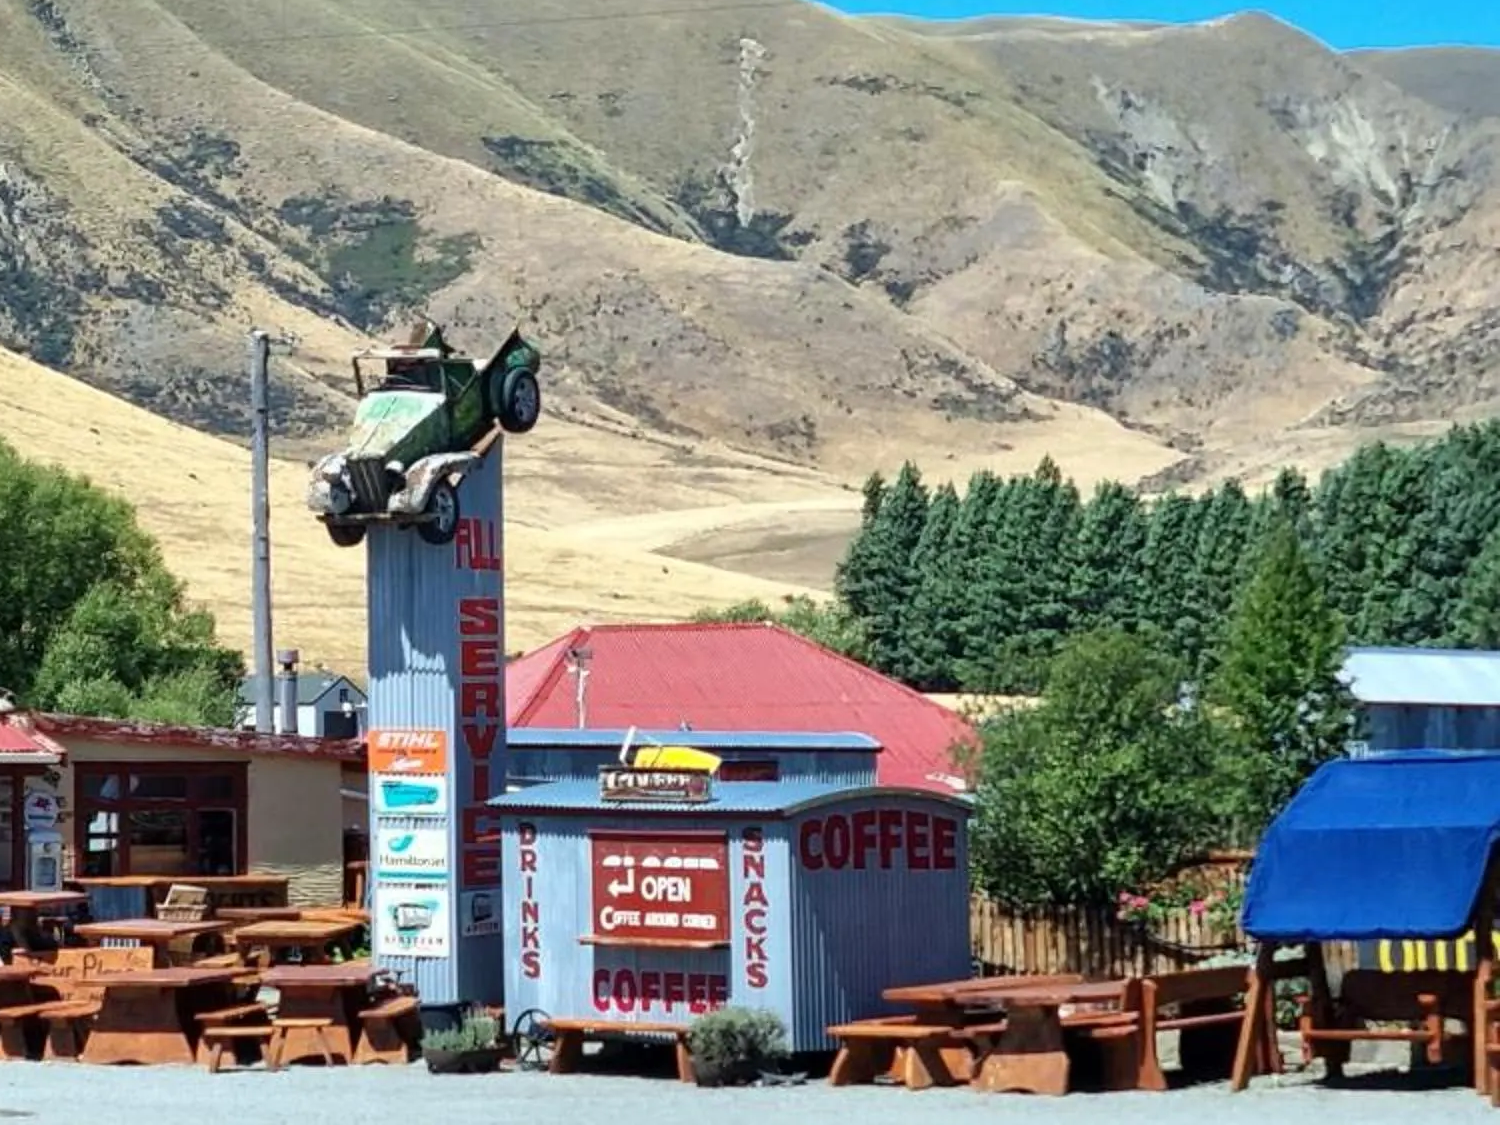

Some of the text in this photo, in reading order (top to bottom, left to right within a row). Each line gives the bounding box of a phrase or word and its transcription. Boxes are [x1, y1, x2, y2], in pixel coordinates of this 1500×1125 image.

[377, 731, 439, 748] STIHL
[458, 598, 501, 887] SERVICE
[800, 809, 957, 871] COFFEE
[518, 821, 541, 979] DRINKS
[641, 876, 691, 902] OPEN
[741, 826, 769, 988] SNACKS
[593, 968, 729, 1014] COFFEE
